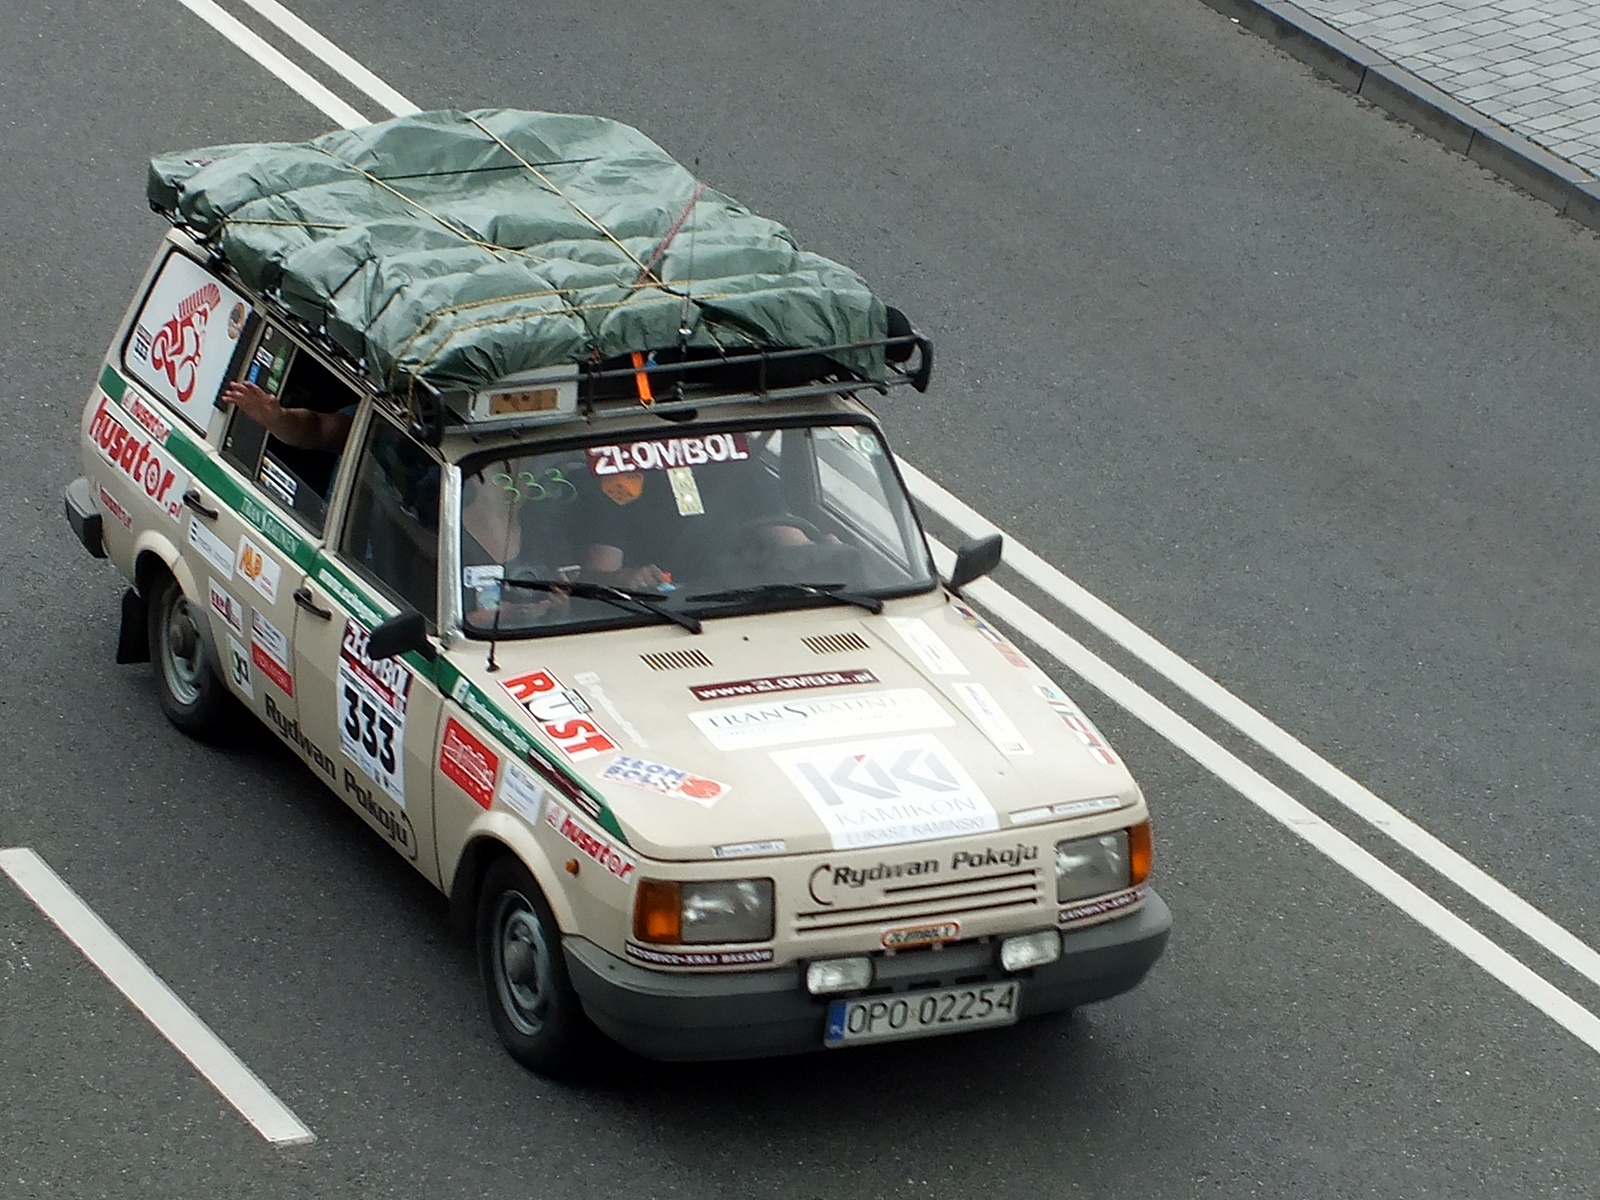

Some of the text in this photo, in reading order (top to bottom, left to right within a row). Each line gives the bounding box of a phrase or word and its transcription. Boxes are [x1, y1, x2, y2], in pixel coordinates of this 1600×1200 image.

[344, 683, 395, 776] 333
[500, 671, 616, 755] RUST
[264, 692, 337, 781] Rydwan
[343, 767, 409, 847] Pokoju
[833, 796, 977, 827] KAMIKON
[832, 844, 1039, 888] Rydwan Pokoju
[919, 986, 1016, 1025] 02254
